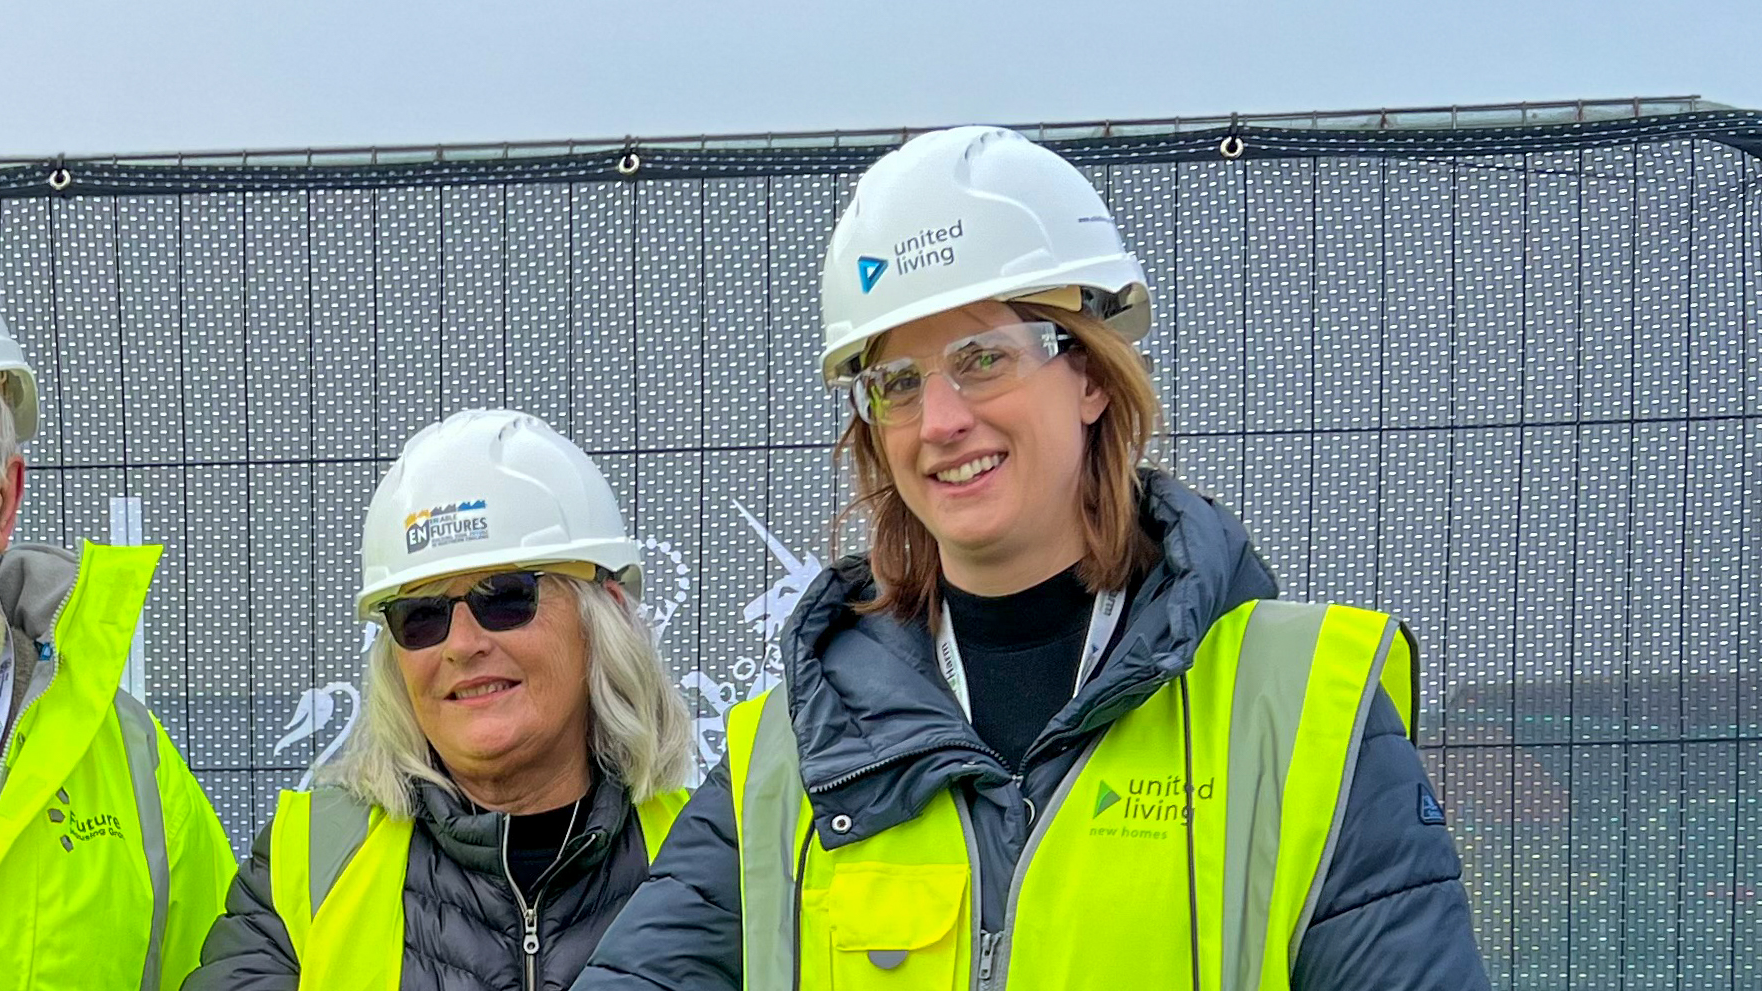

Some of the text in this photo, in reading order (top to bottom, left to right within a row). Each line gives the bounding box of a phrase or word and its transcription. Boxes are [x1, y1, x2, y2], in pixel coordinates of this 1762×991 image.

[894, 219, 963, 256] united
[896, 246, 955, 276] living
[408, 526, 428, 546] EN
[430, 517, 488, 538] FUTURES
[941, 642, 956, 680] Harm
[69, 810, 121, 833] Future
[1089, 826, 1168, 840] new homes
